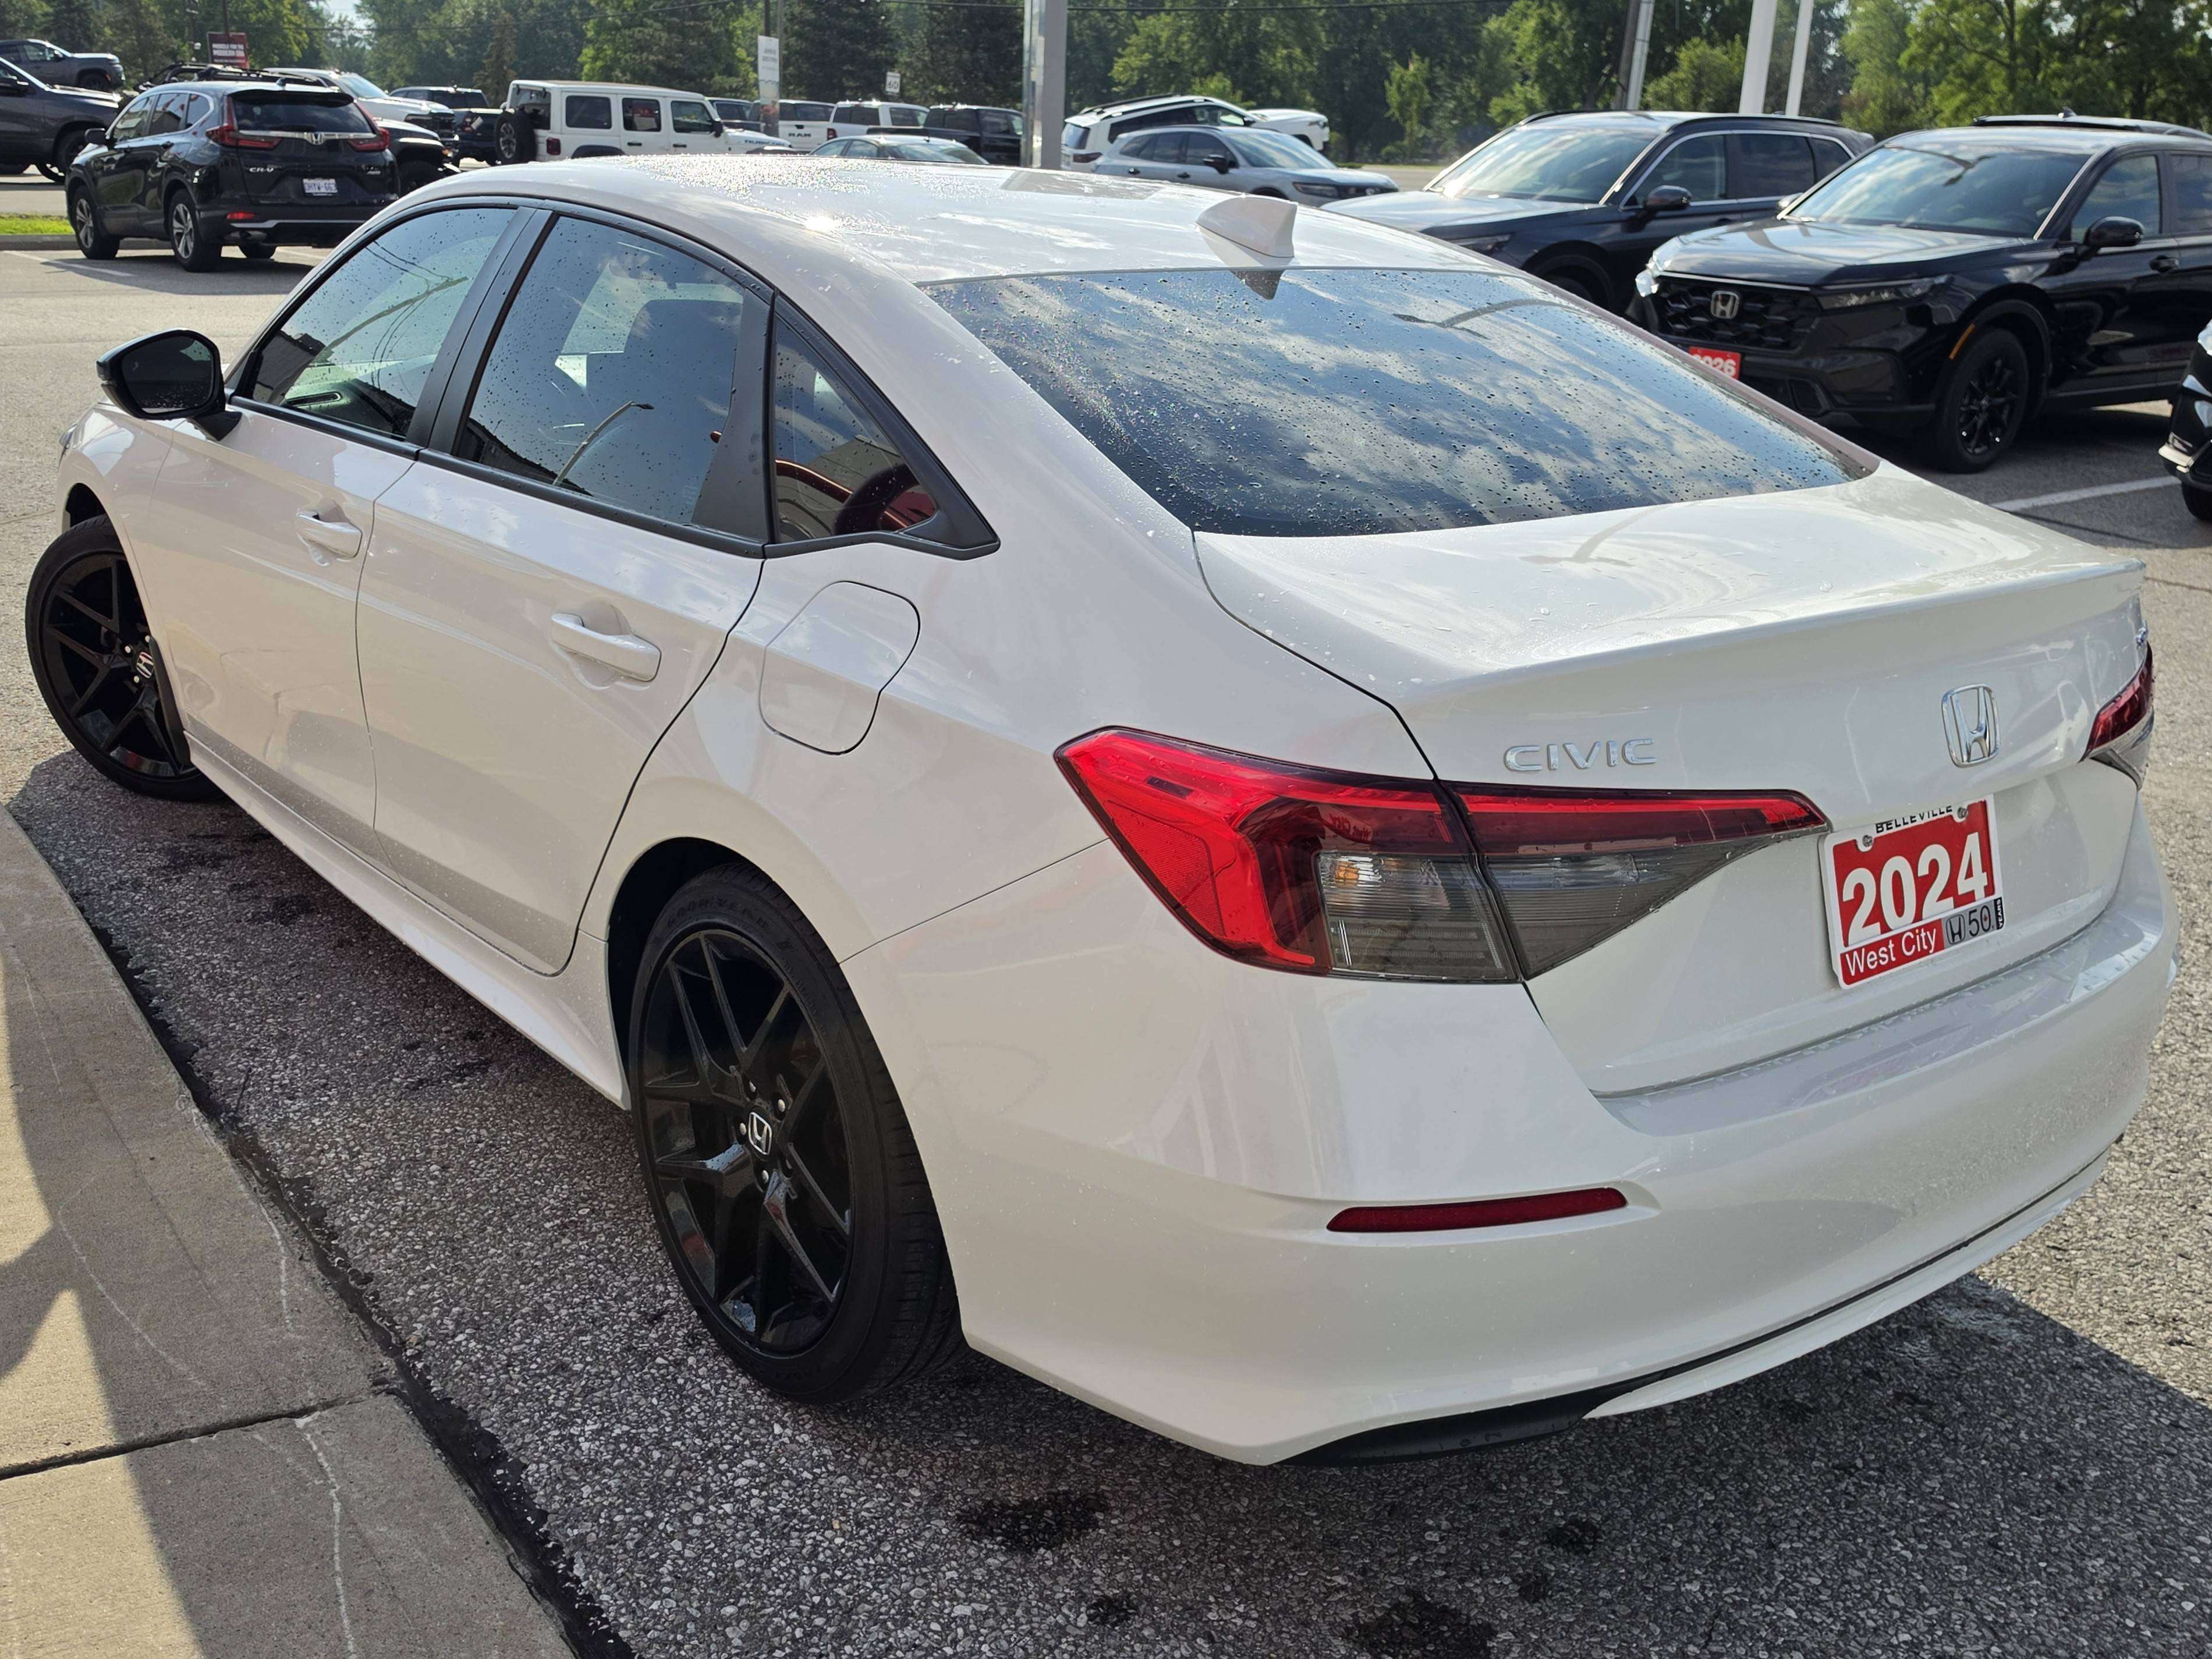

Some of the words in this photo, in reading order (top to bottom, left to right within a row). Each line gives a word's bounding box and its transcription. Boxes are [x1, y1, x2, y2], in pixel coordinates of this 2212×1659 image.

[1504, 738, 1658, 771] CIVIC
[1876, 806, 1953, 834] BELLEVILLE
[1842, 832, 1988, 946] 2024
[1969, 905, 1991, 937] 50
[1845, 939, 1896, 976] West
[1901, 927, 1936, 956] City
